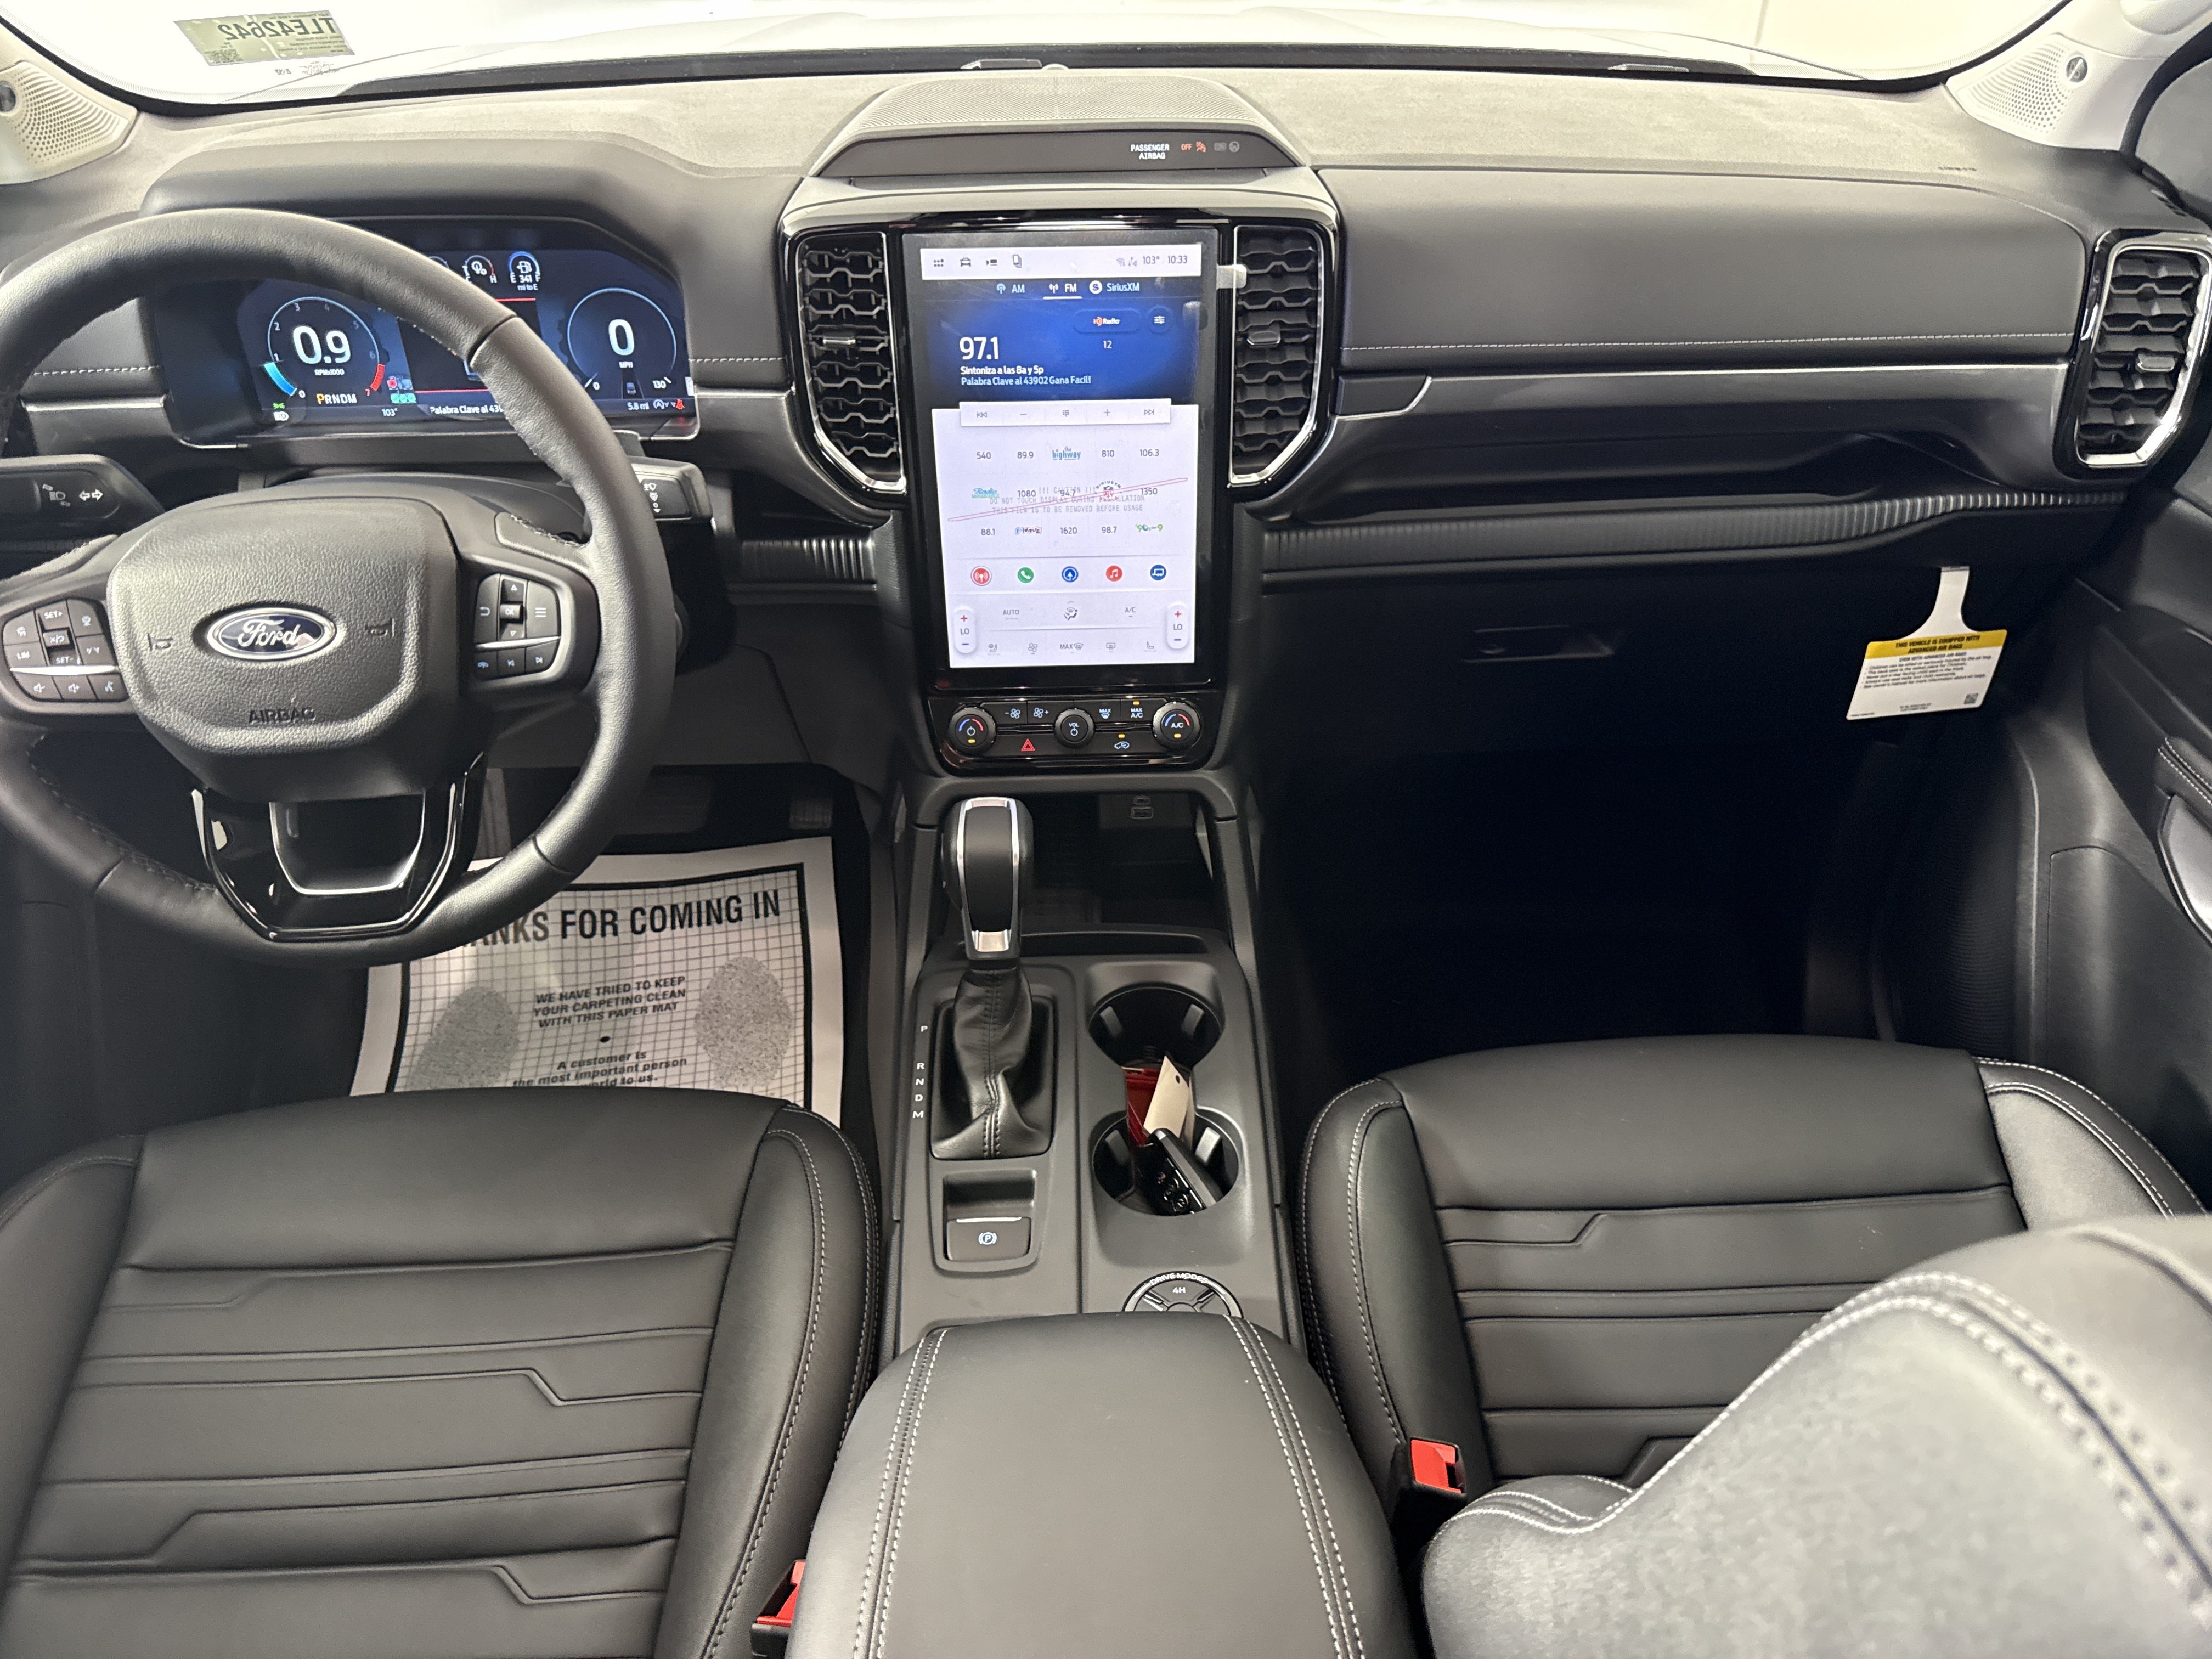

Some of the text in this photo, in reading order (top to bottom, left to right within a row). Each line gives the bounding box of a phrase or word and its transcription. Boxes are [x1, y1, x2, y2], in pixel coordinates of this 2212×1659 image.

[1130, 143, 1170, 151] PASSENGER
[1143, 256, 1160, 264] 103°
[1167, 255, 1188, 264] 10:33
[510, 274, 517, 283] E
[519, 274, 533, 283] 341
[1012, 284, 1025, 293] AM
[1065, 283, 1077, 292] FM
[1107, 282, 1140, 292] SiriusXM
[294, 303, 300, 311] 3
[274, 322, 280, 331] 2
[608, 319, 635, 356] 0
[293, 326, 351, 364] 0.9
[960, 336, 999, 360] 97.1
[1103, 340, 1113, 349] 12
[274, 353, 279, 362] 1
[960, 366, 997, 375] Sintoniza
[1003, 365, 1015, 374] las
[1016, 365, 1027, 374] 8a
[1027, 367, 1032, 375] y
[1033, 365, 1044, 375] 5p
[592, 381, 600, 390] 0
[652, 380, 667, 388] 130
[961, 377, 991, 386] Palabra
[992, 376, 1014, 385] Clave
[1015, 376, 1023, 385] al
[1023, 376, 1048, 385] 43902
[1049, 376, 1070, 385] Gana
[316, 393, 357, 404] PRNDM
[430, 406, 459, 415] Palabra
[459, 405, 480, 414] Clave
[627, 402, 640, 410] 5.8
[382, 408, 398, 416] 103°
[976, 452, 991, 460] 540
[1017, 451, 1034, 459] 89.9
[1052, 449, 1081, 460] highway
[1139, 449, 1159, 457] 106.3
[44, 611, 63, 619] SET+
[238, 619, 301, 647] Ford
[16, 651, 30, 661] LIM
[249, 708, 316, 723] AIRBAG
[561, 909, 619, 939] FOR
[631, 895, 743, 935] COMING
[753, 889, 780, 919] IN
[537, 975, 686, 1004] WE HAVE TRIED TO KEEP
[534, 989, 686, 1017] YOUR CARPETING CLEAN
[539, 1002, 679, 1028] WITH THIS PAPER MAT
[557, 1051, 647, 1070] A customer is
[538, 1073, 571, 1085] most
[575, 1063, 639, 1079] important
[640, 1057, 687, 1072] person
[620, 1075, 634, 1085] to
[638, 1073, 658, 1083] us.
[1149, 1272, 1209, 1286] DRIVE MODES
